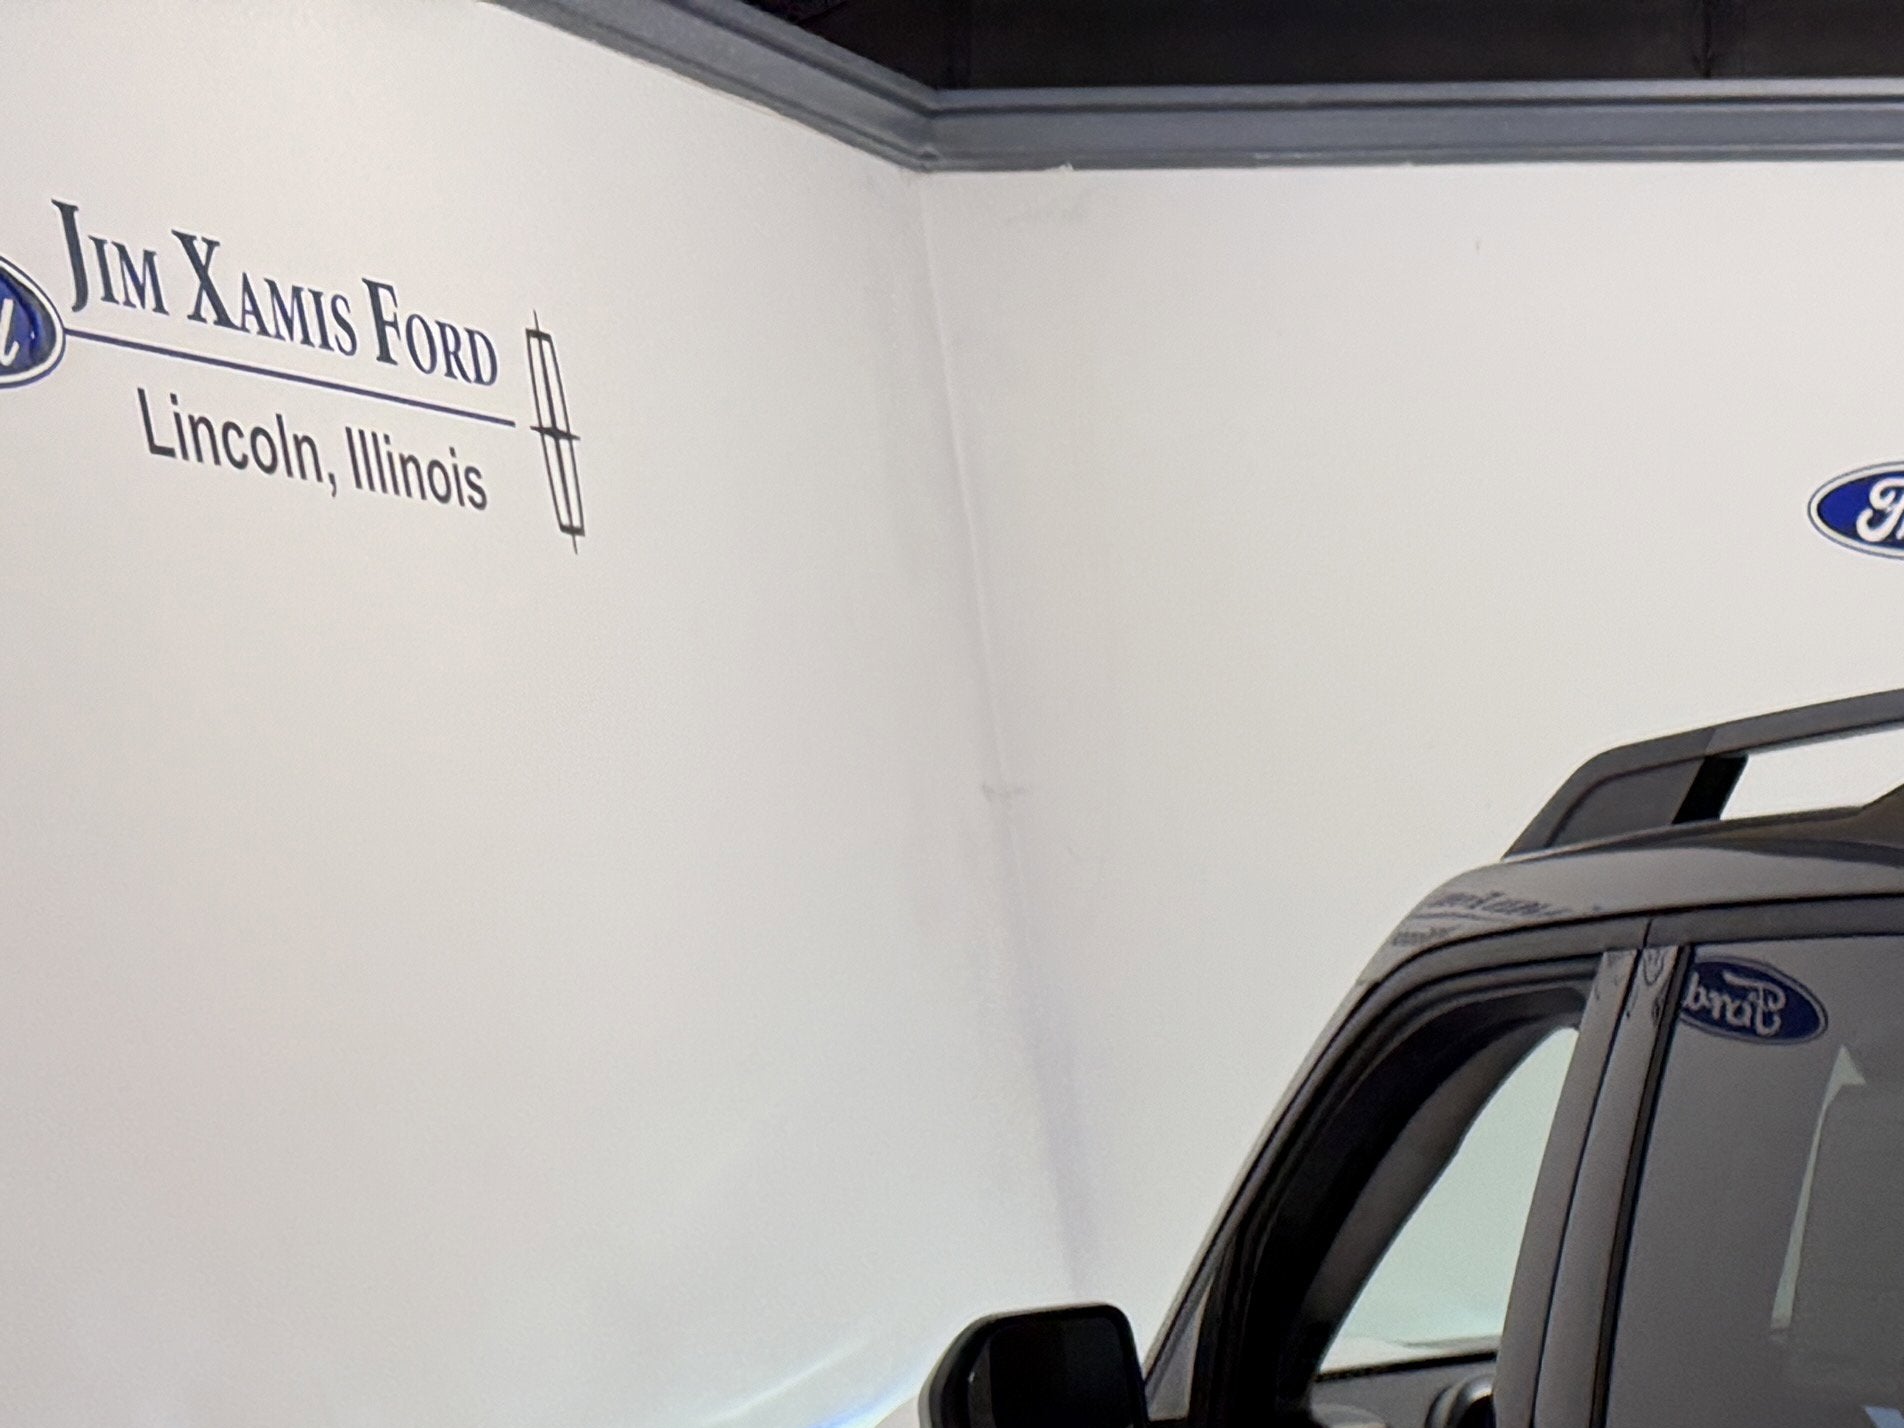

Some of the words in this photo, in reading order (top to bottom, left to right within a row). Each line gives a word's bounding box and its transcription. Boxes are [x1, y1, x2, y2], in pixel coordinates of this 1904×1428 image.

[51, 198, 170, 315] JIM
[171, 229, 359, 356] XAMIS
[362, 277, 499, 387] FORD
[137, 387, 338, 496] Lincoln,
[345, 426, 487, 510] Illinois
